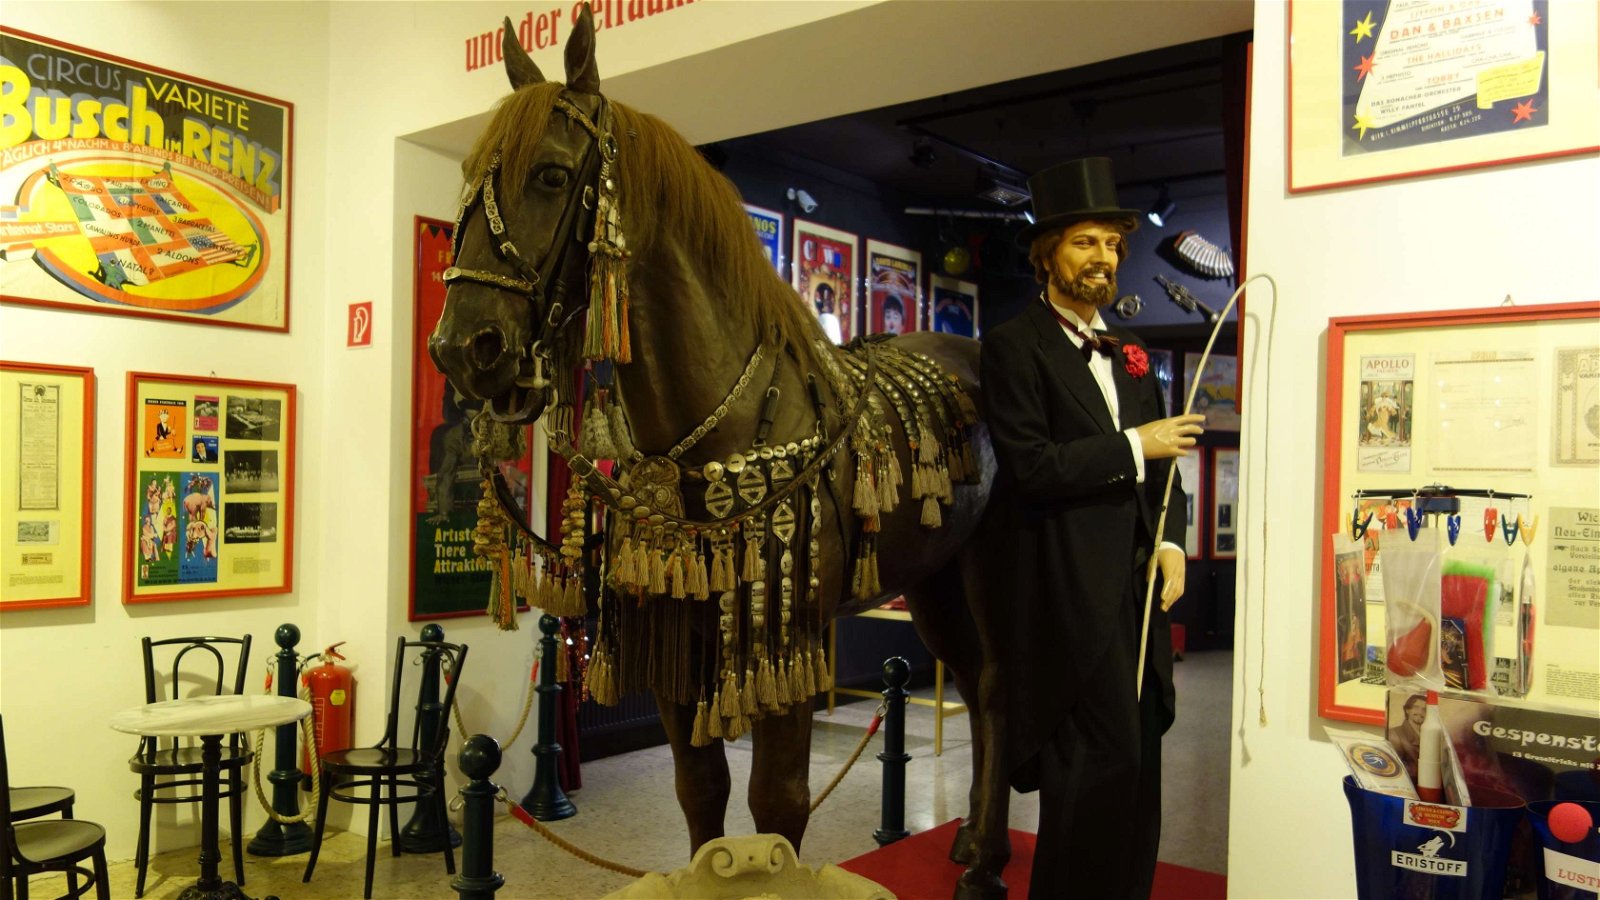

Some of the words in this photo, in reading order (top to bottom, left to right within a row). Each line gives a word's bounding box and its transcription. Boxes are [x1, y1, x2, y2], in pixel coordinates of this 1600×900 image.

[519, 9, 561, 54] der
[1390, 26, 1421, 40] DAN
[1428, 23, 1436, 32] &
[1442, 8, 1504, 29] BAXSEN
[1407, 55, 1425, 64] THE
[27, 52, 121, 92] CIRCUS
[174, 154, 191, 164] BEI
[183, 117, 277, 197] RENZ
[1366, 359, 1410, 370] APOLLO
[434, 527, 477, 543] Artiste
[434, 543, 466, 558] Tiere
[433, 558, 493, 574] Attraktion
[1472, 720, 1600, 752] Gespenst
[1396, 854, 1462, 873] ERISTOFF
